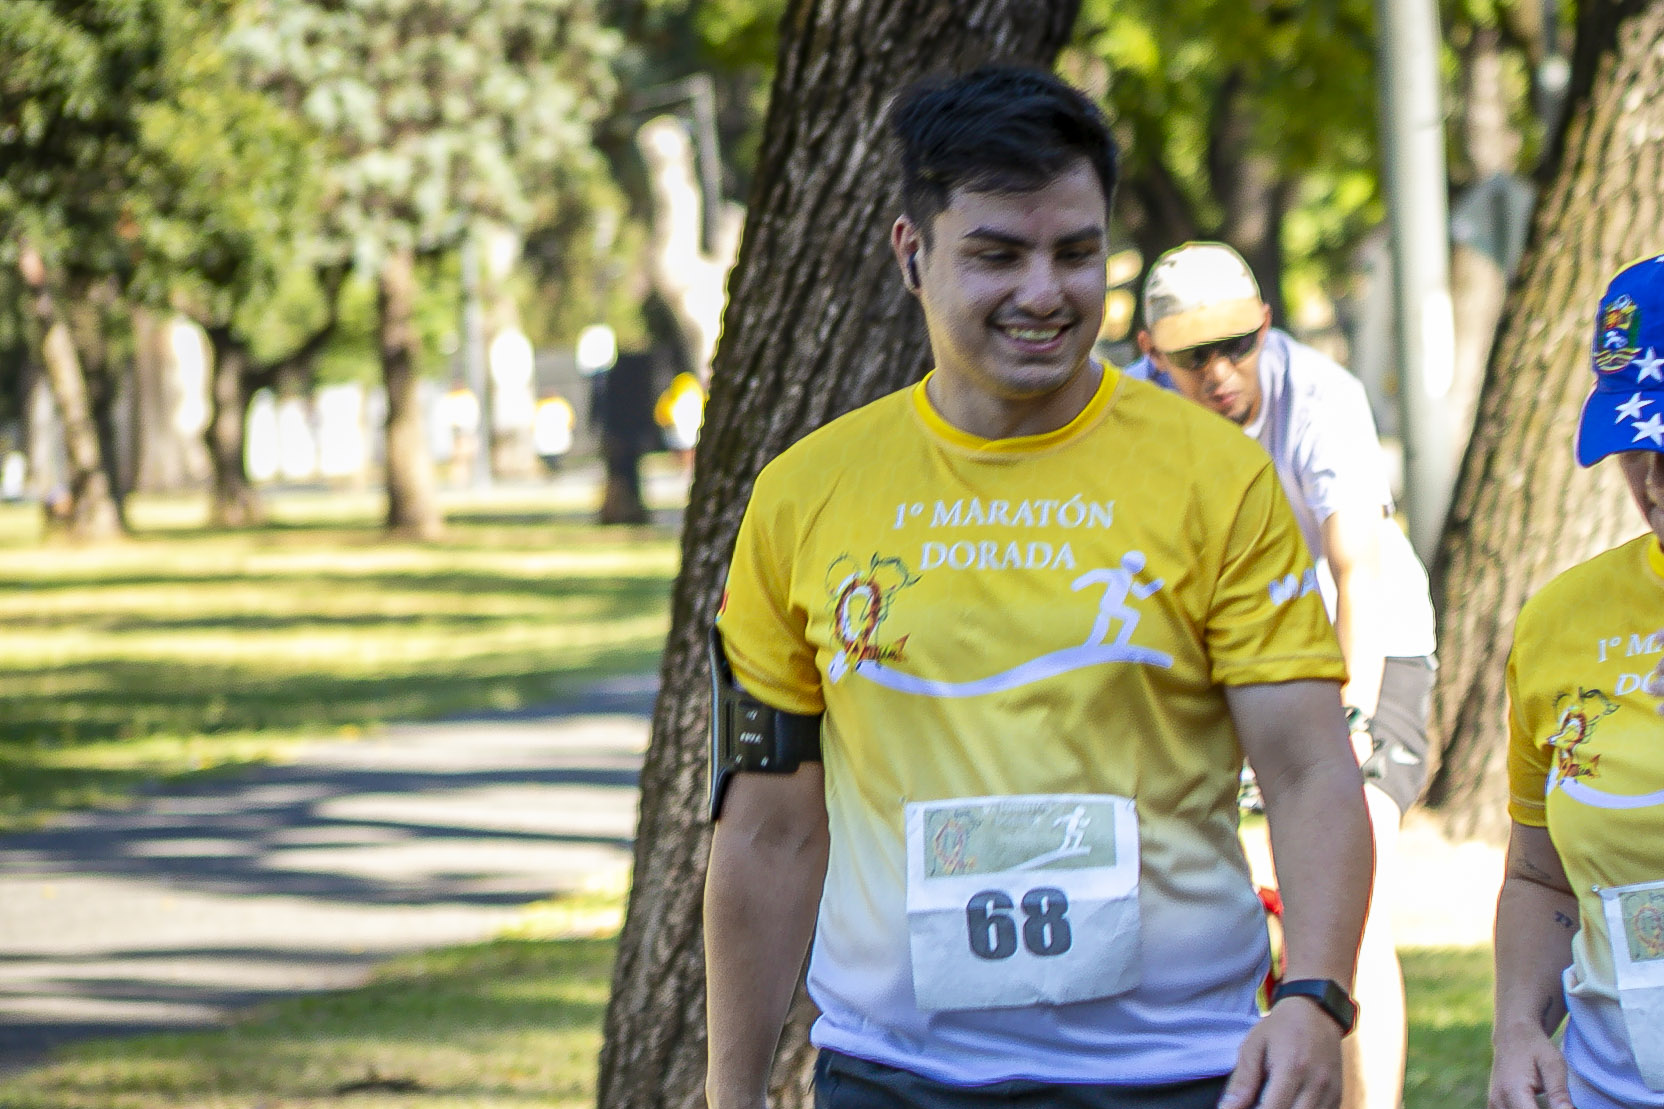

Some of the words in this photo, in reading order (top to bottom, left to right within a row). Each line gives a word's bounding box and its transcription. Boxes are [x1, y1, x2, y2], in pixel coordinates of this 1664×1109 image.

[930, 493, 1115, 529] MARATÓN
[919, 540, 1076, 570] DORADA
[966, 887, 1072, 961] 68
